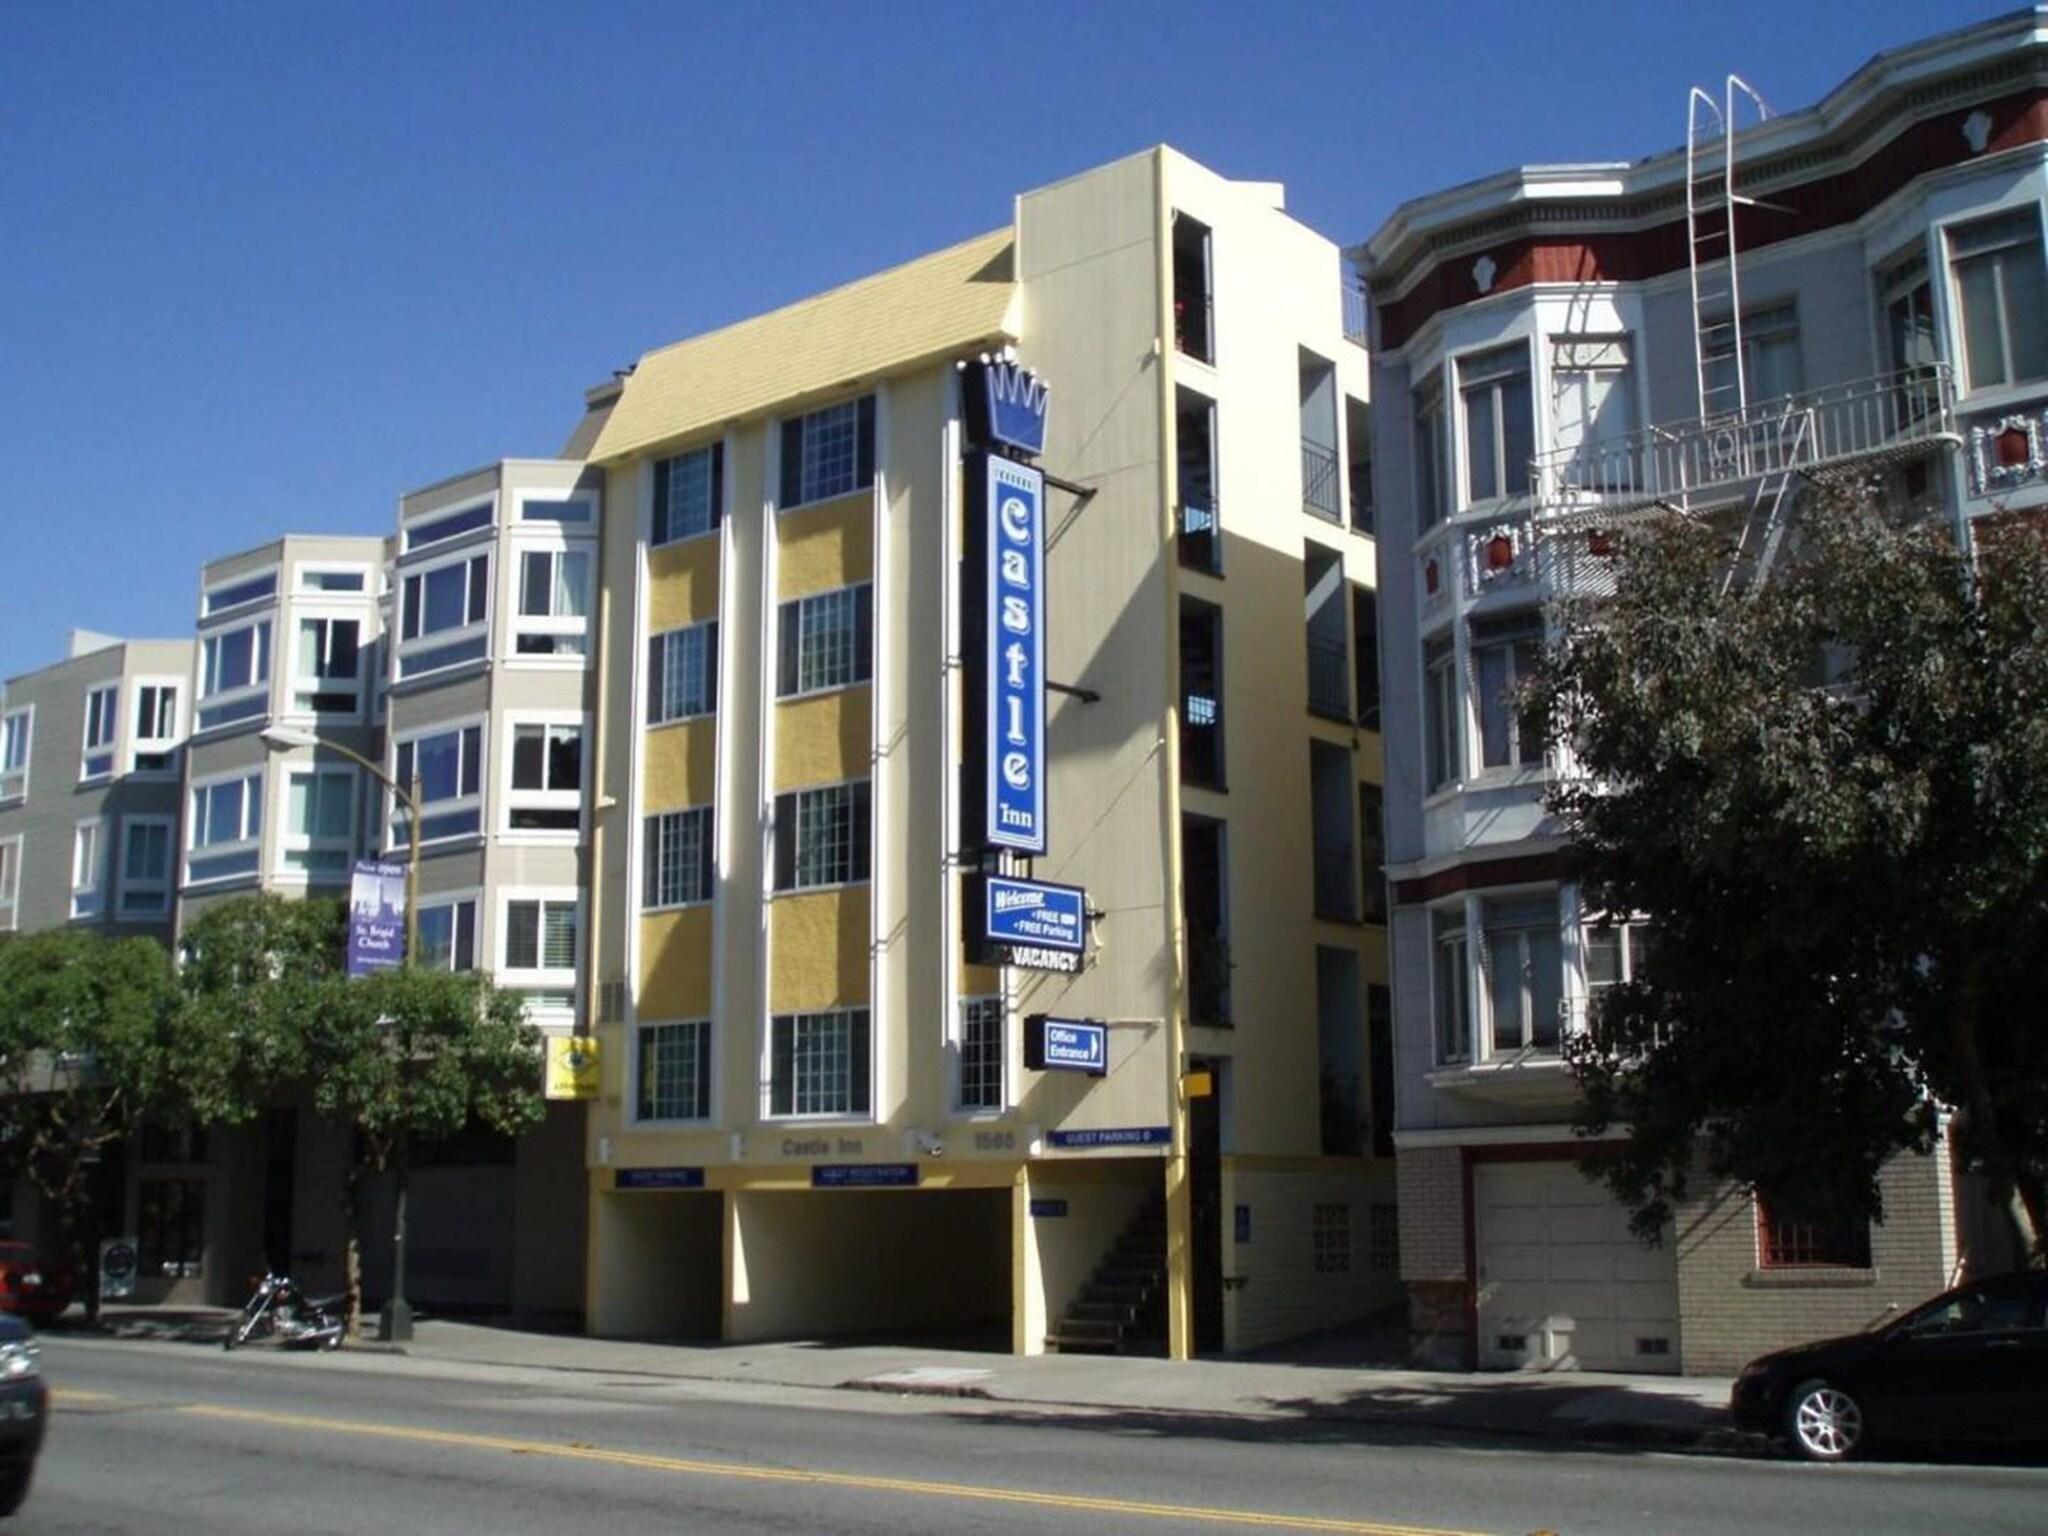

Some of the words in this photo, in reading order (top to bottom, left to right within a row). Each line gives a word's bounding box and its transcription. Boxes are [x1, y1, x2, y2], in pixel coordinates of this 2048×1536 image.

[1001, 496, 1031, 790] Castle
[1000, 803, 1032, 827] Inn
[995, 890, 1044, 909] Welcome
[1037, 911, 1059, 924] FREE
[1019, 920, 1042, 934] FREE
[1043, 923, 1074, 940] Parking
[1013, 947, 1079, 971] VACANCY
[1051, 1029, 1076, 1043] Office
[1051, 1045, 1089, 1060] Entrance
[782, 1137, 830, 1156] Castle
[838, 1137, 863, 1154] Inn
[1065, 1132, 1097, 1145] GUEST
[1098, 1131, 1141, 1143] PARKING
